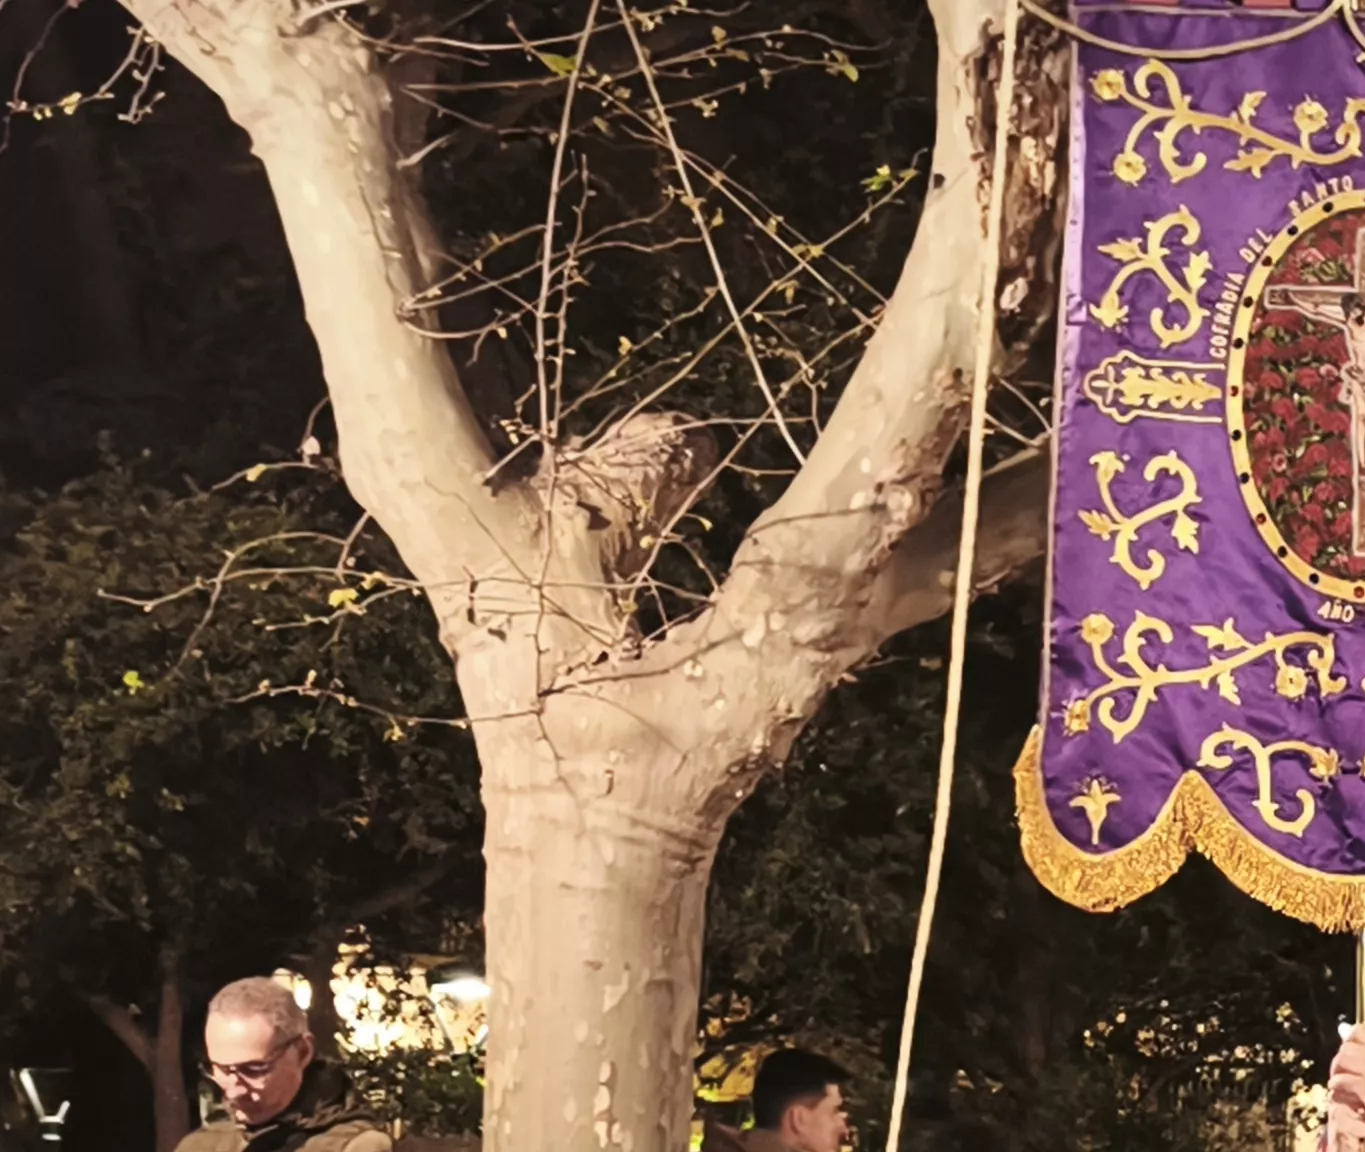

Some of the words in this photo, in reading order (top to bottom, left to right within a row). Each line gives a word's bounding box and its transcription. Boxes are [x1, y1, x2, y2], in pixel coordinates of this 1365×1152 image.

[1239, 228, 1273, 263] DEL
[1288, 175, 1354, 217] SANTO
[1317, 599, 1354, 623] AÑO
